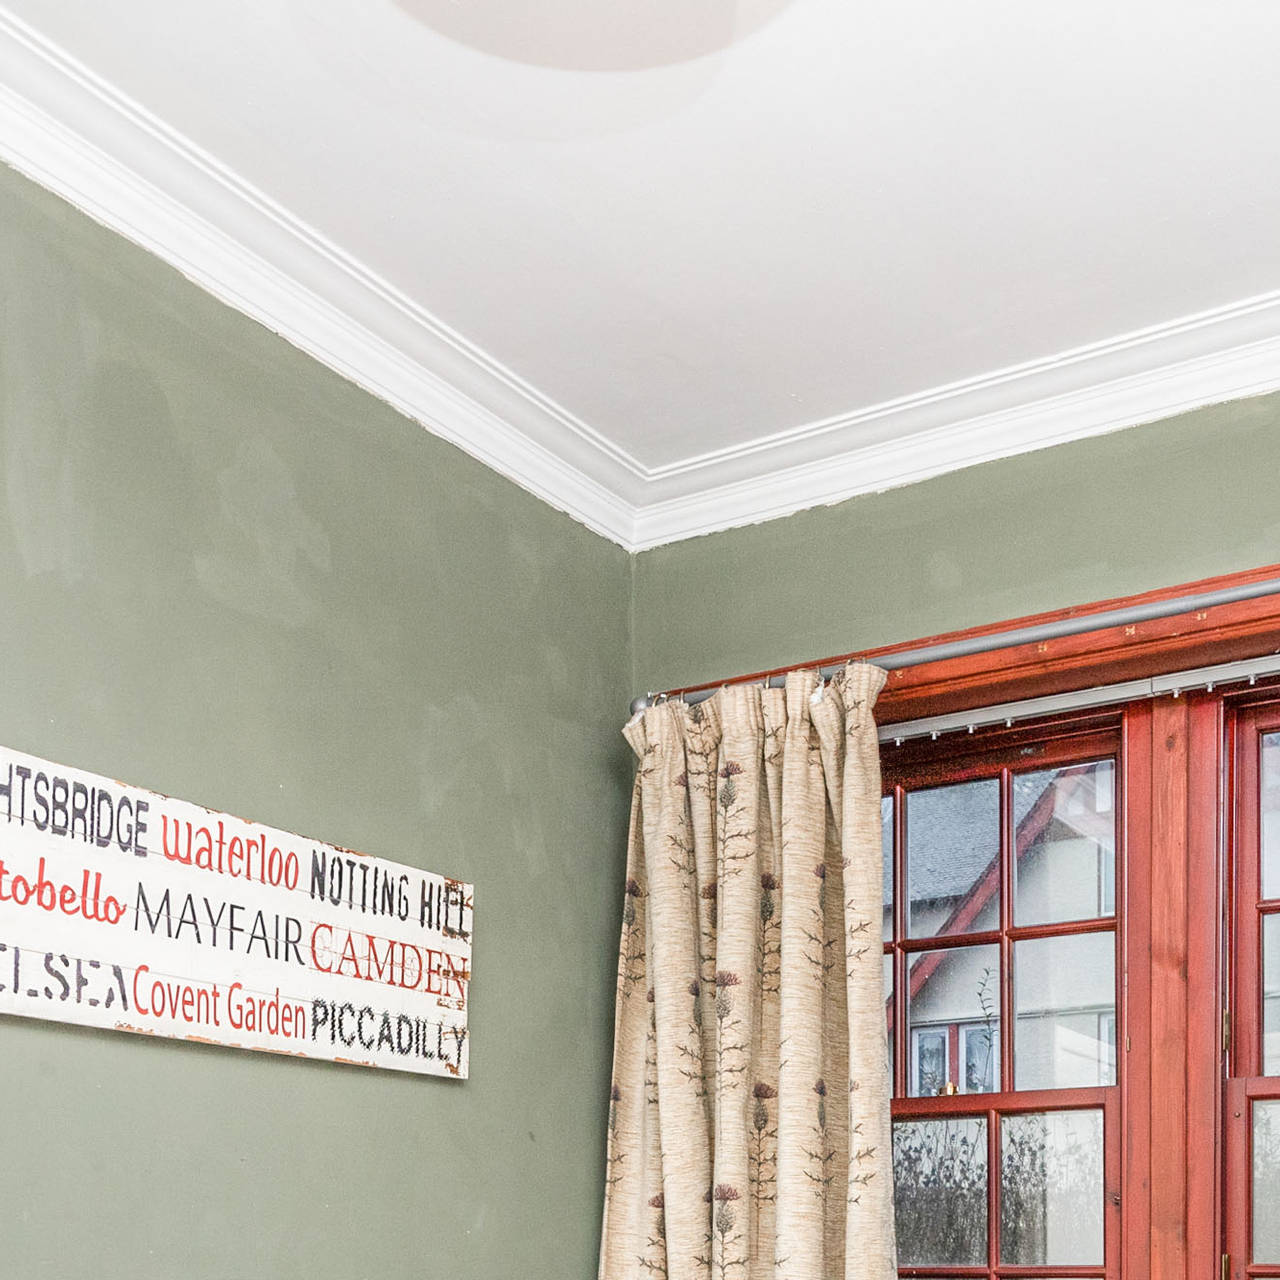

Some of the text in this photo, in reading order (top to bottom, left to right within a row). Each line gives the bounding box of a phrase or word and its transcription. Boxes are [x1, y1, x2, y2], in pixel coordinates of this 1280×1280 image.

[161, 813, 300, 891] waterloo
[309, 848, 410, 922] NOTTING
[420, 878, 470, 939] HILL
[133, 881, 306, 966] MAYFAIR
[311, 922, 469, 999] CAMDEN
[132, 964, 221, 1027] Covent
[227, 981, 307, 1040] Garden
[310, 998, 468, 1066] PICCADILLY
